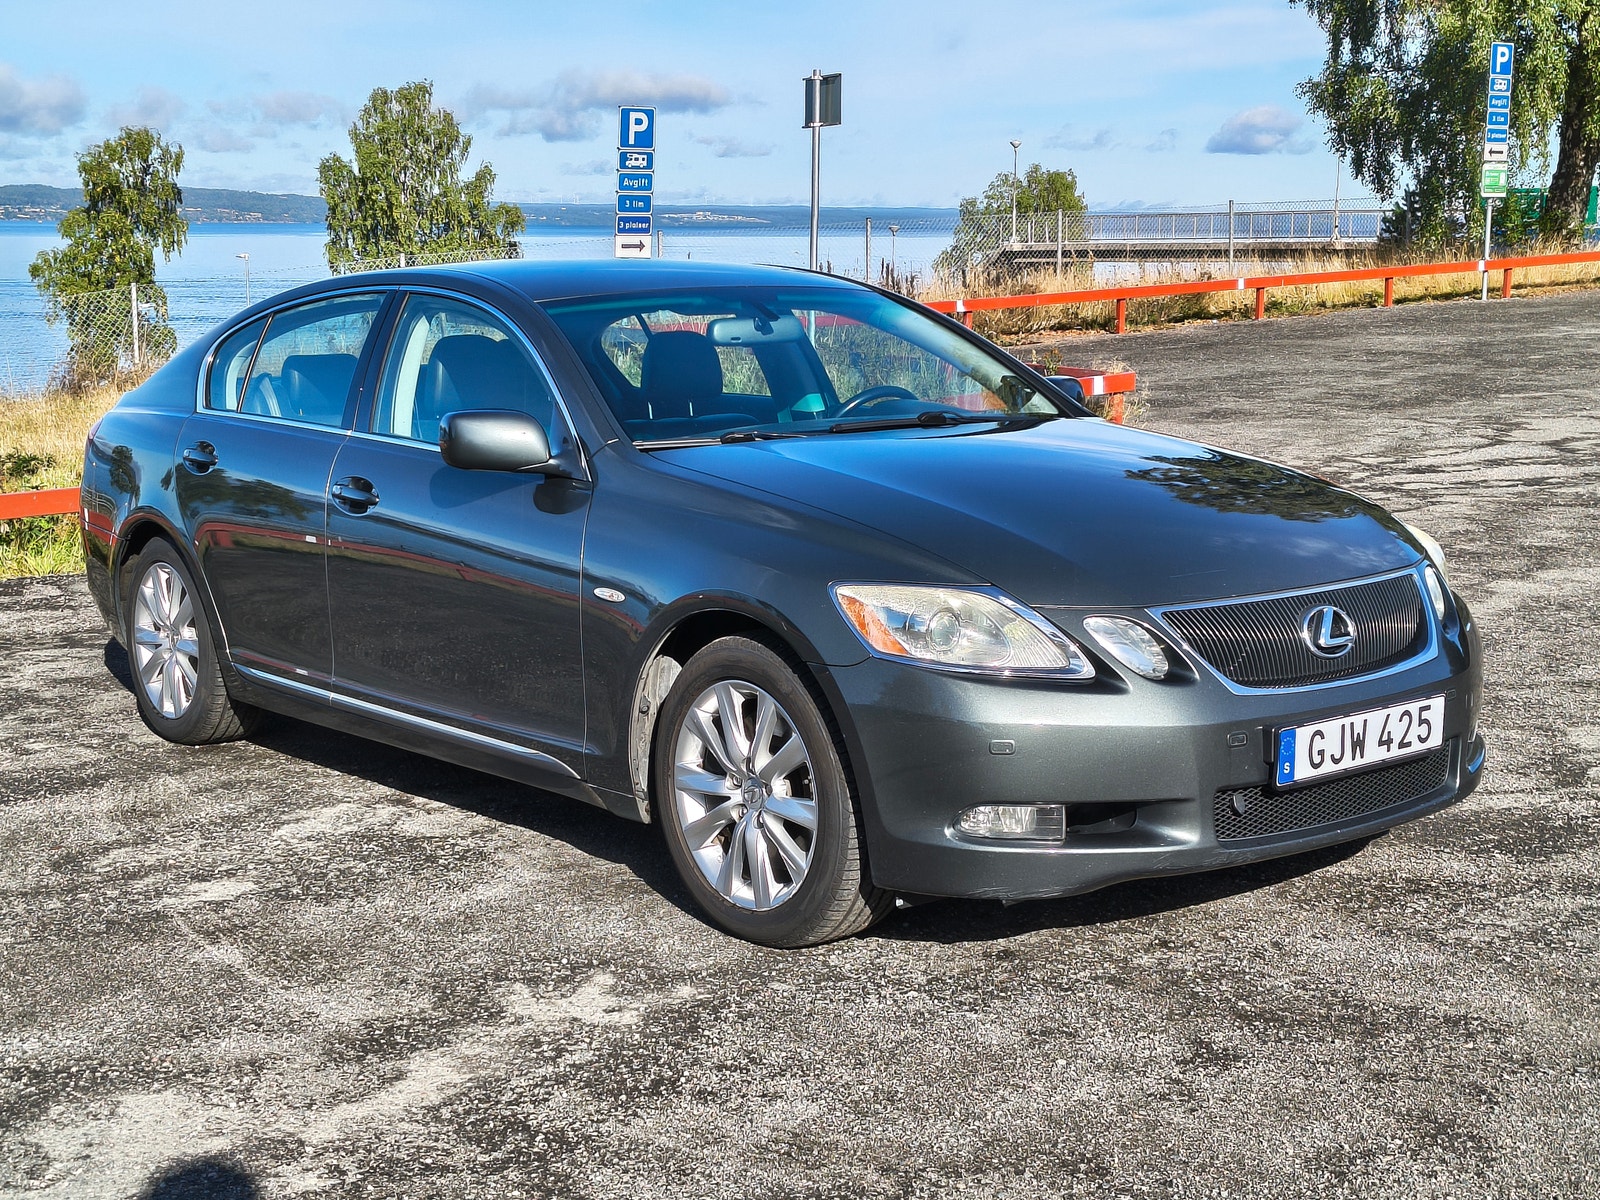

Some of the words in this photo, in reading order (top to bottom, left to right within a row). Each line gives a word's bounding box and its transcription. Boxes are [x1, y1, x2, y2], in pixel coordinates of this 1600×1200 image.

[1496, 46, 1509, 72] P
[628, 111, 649, 145] P
[623, 177, 648, 188] Avgift
[625, 199, 630, 208] 3
[619, 221, 624, 229] 3
[1308, 718, 1368, 769] GJW
[1377, 704, 1432, 752] 425
[1283, 762, 1291, 774] S
